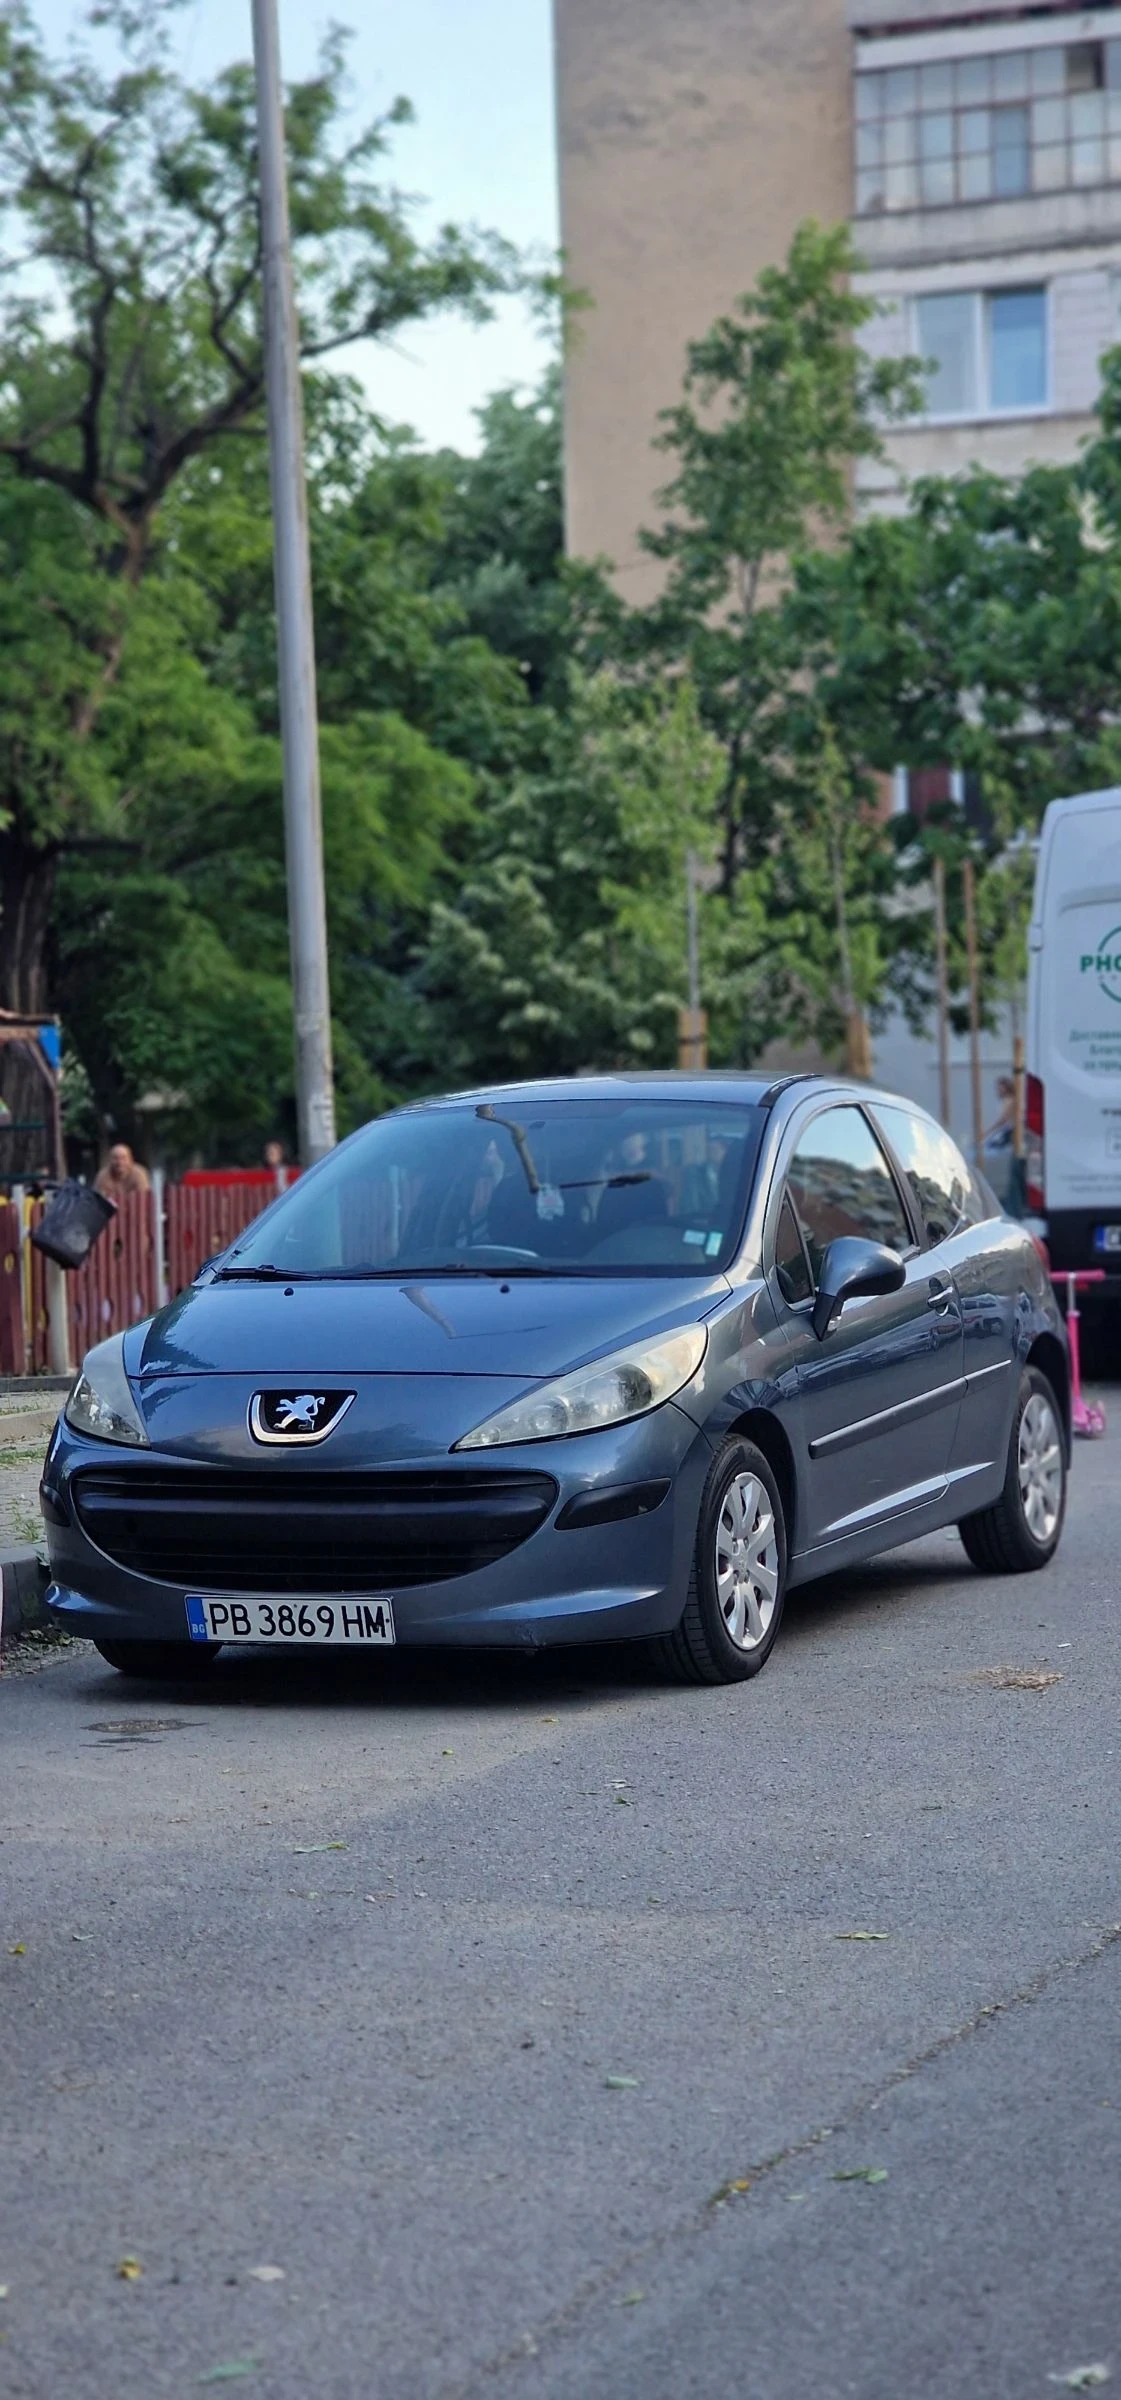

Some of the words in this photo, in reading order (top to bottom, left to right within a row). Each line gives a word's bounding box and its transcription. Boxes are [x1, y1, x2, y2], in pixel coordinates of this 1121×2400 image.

[192, 1623, 206, 1634] BG
[208, 1603, 252, 1636] PB
[258, 1604, 336, 1637] 3869
[341, 1605, 387, 1638] HM
